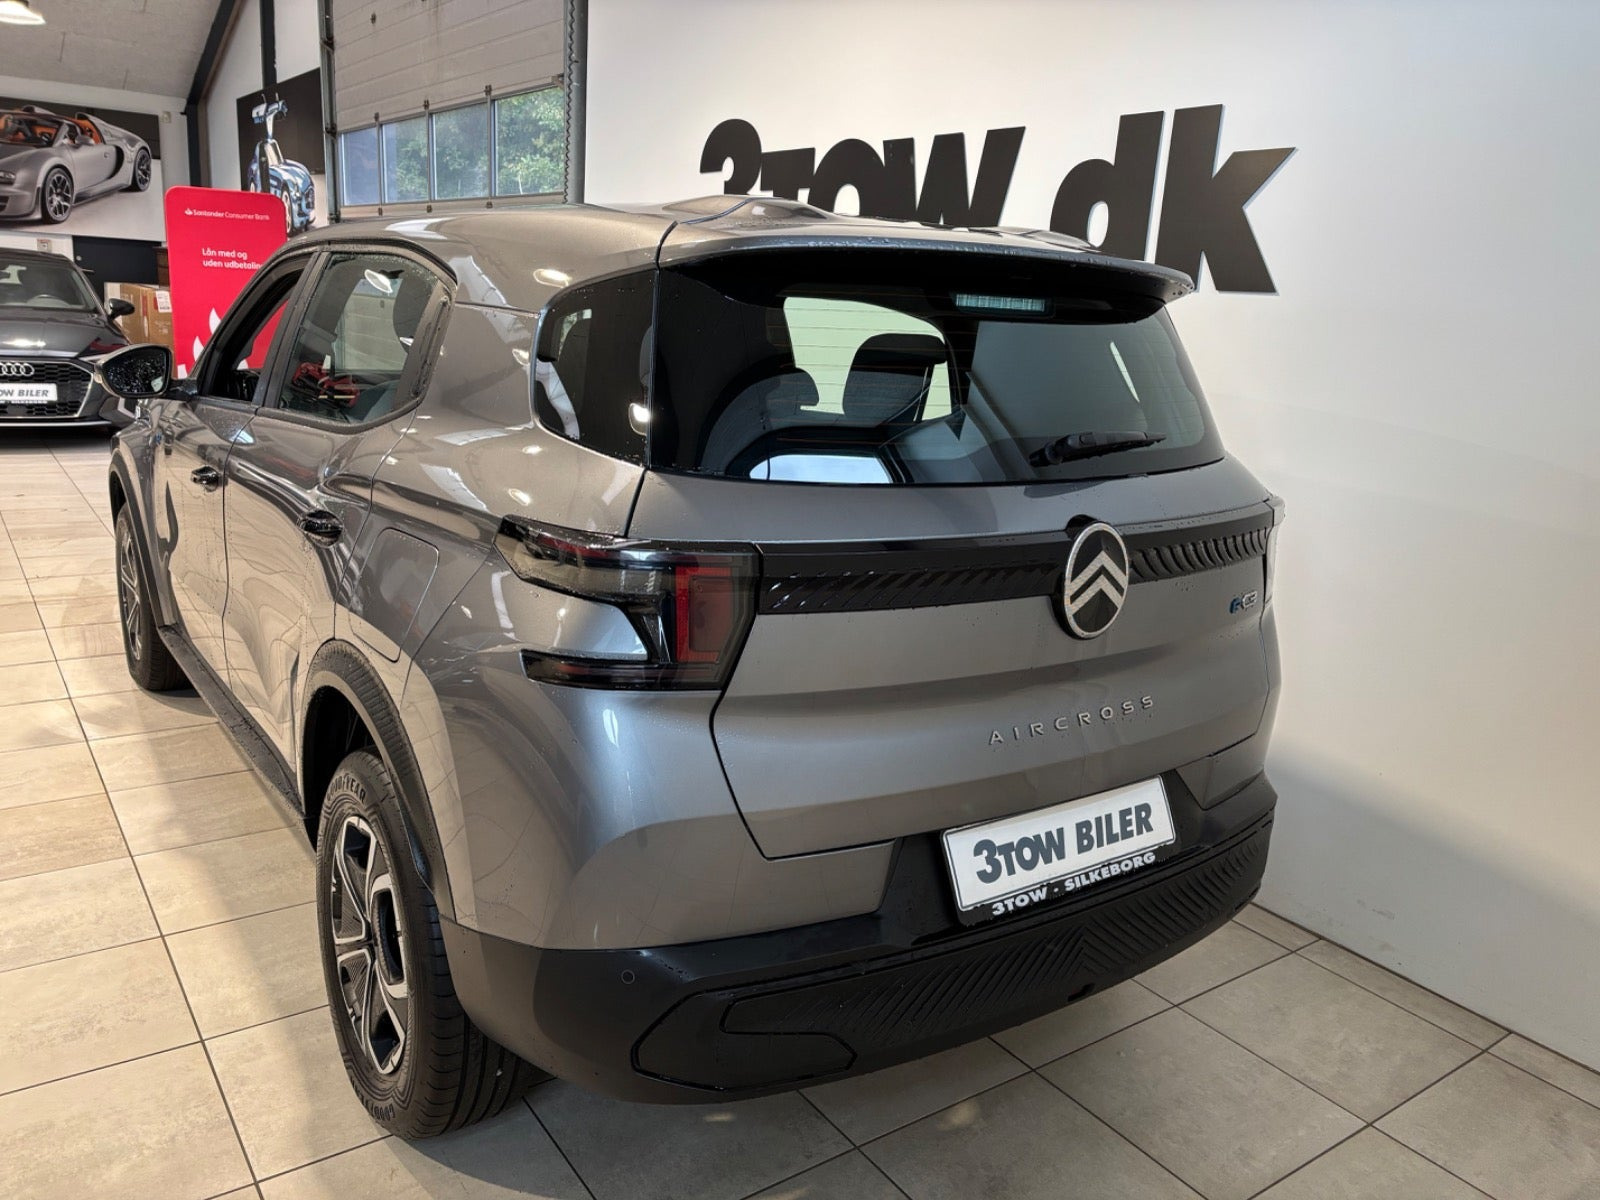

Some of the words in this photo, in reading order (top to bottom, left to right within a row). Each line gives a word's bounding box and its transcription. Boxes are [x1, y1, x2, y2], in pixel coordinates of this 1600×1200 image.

[193, 208, 224, 218] Santander
[225, 211, 255, 220] Consumer
[255, 213, 270, 221] Bank
[202, 247, 216, 256] Lån
[218, 250, 236, 258] med
[237, 252, 247, 260] og
[203, 259, 223, 268] uden
[18, 389, 49, 397] BILER
[989, 695, 1153, 745] AIRCROSS
[973, 827, 1066, 884] 3TOW
[1075, 802, 1154, 855] BILER
[992, 886, 1048, 916] 3TOW
[1064, 852, 1156, 892] SILKEBORG
